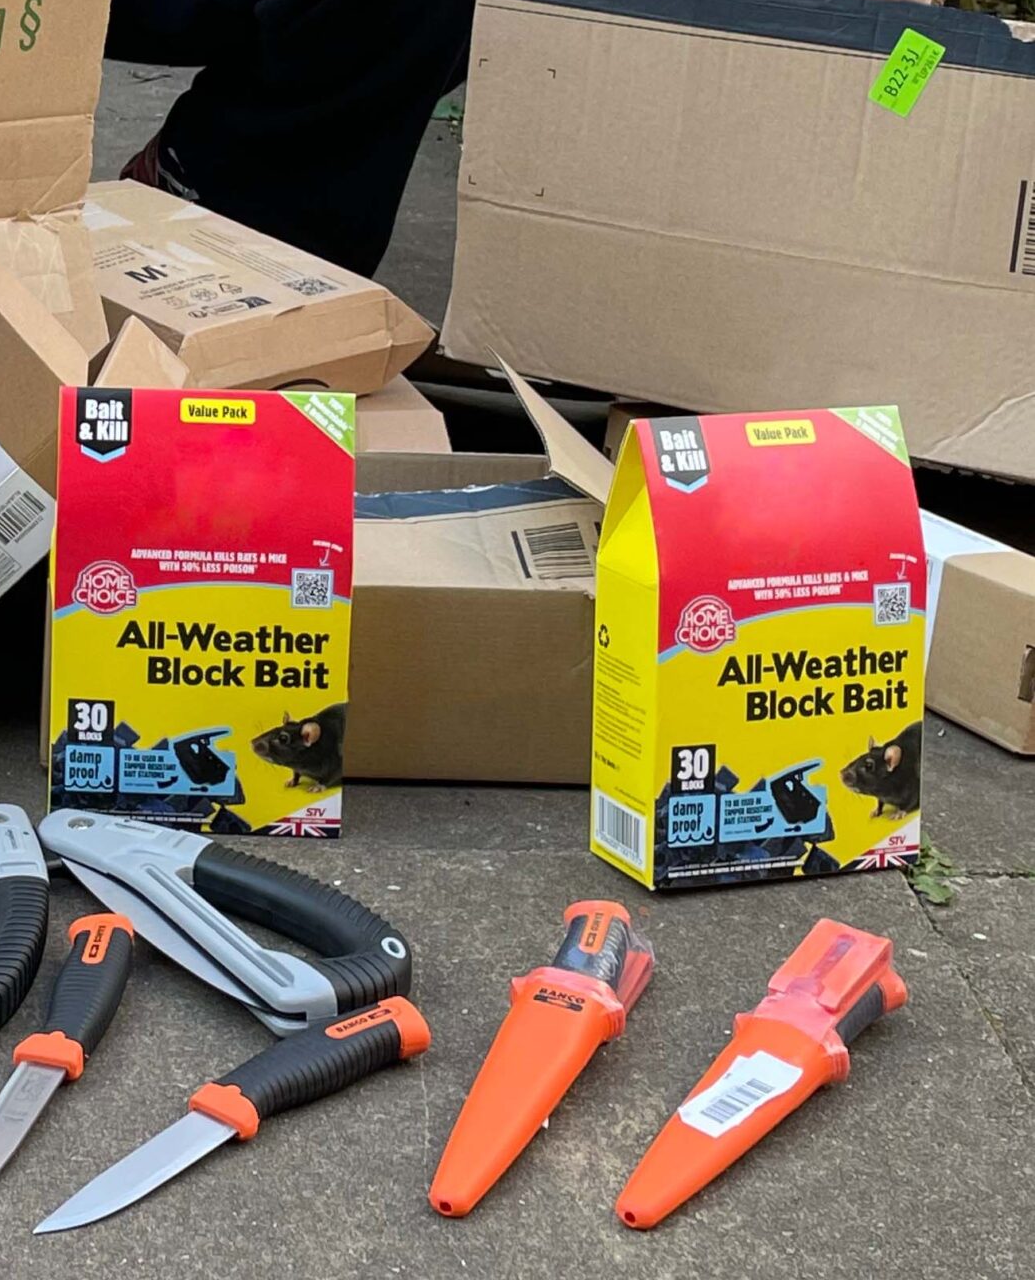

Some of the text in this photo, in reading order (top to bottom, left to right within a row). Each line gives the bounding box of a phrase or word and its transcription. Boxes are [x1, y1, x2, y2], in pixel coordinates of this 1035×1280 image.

[85, 399, 123, 420] Bait
[188, 405, 247, 418] Value Pack
[80, 419, 128, 441] & Kill
[660, 426, 697, 452] Bait
[753, 426, 808, 441] Value Pack
[662, 448, 708, 473] & Kill
[131, 549, 287, 564] ADVANCED FORMULA KILLS RATS & MICE
[159, 561, 180, 571] WITH
[181, 561, 200, 572] 50%
[202, 562, 221, 573] LESS
[81, 573, 129, 590] HOME
[728, 570, 869, 590] ADVANCED FORMULA KILLS RATS & MICE
[76, 587, 137, 605] CHOICE
[754, 589, 774, 600] WITH
[774, 588, 792, 599] 50%
[793, 586, 810, 598] LESS
[684, 608, 730, 626] HOME
[117, 621, 330, 654] All-Weather
[679, 623, 735, 641] CHOICE
[147, 657, 329, 690] Block Bait
[717, 647, 909, 687] All-Weather
[747, 680, 908, 722] Block Bait
[74, 702, 108, 732] 30
[69, 749, 102, 768] damp
[677, 748, 709, 780] 30
[69, 766, 99, 780] proof
[305, 807, 327, 818] STV
[673, 801, 703, 817] damp
[672, 816, 701, 834] proof
[888, 835, 906, 846] STV
[539, 987, 585, 1004] BAHCO
[336, 1016, 368, 1033] BAHCO
